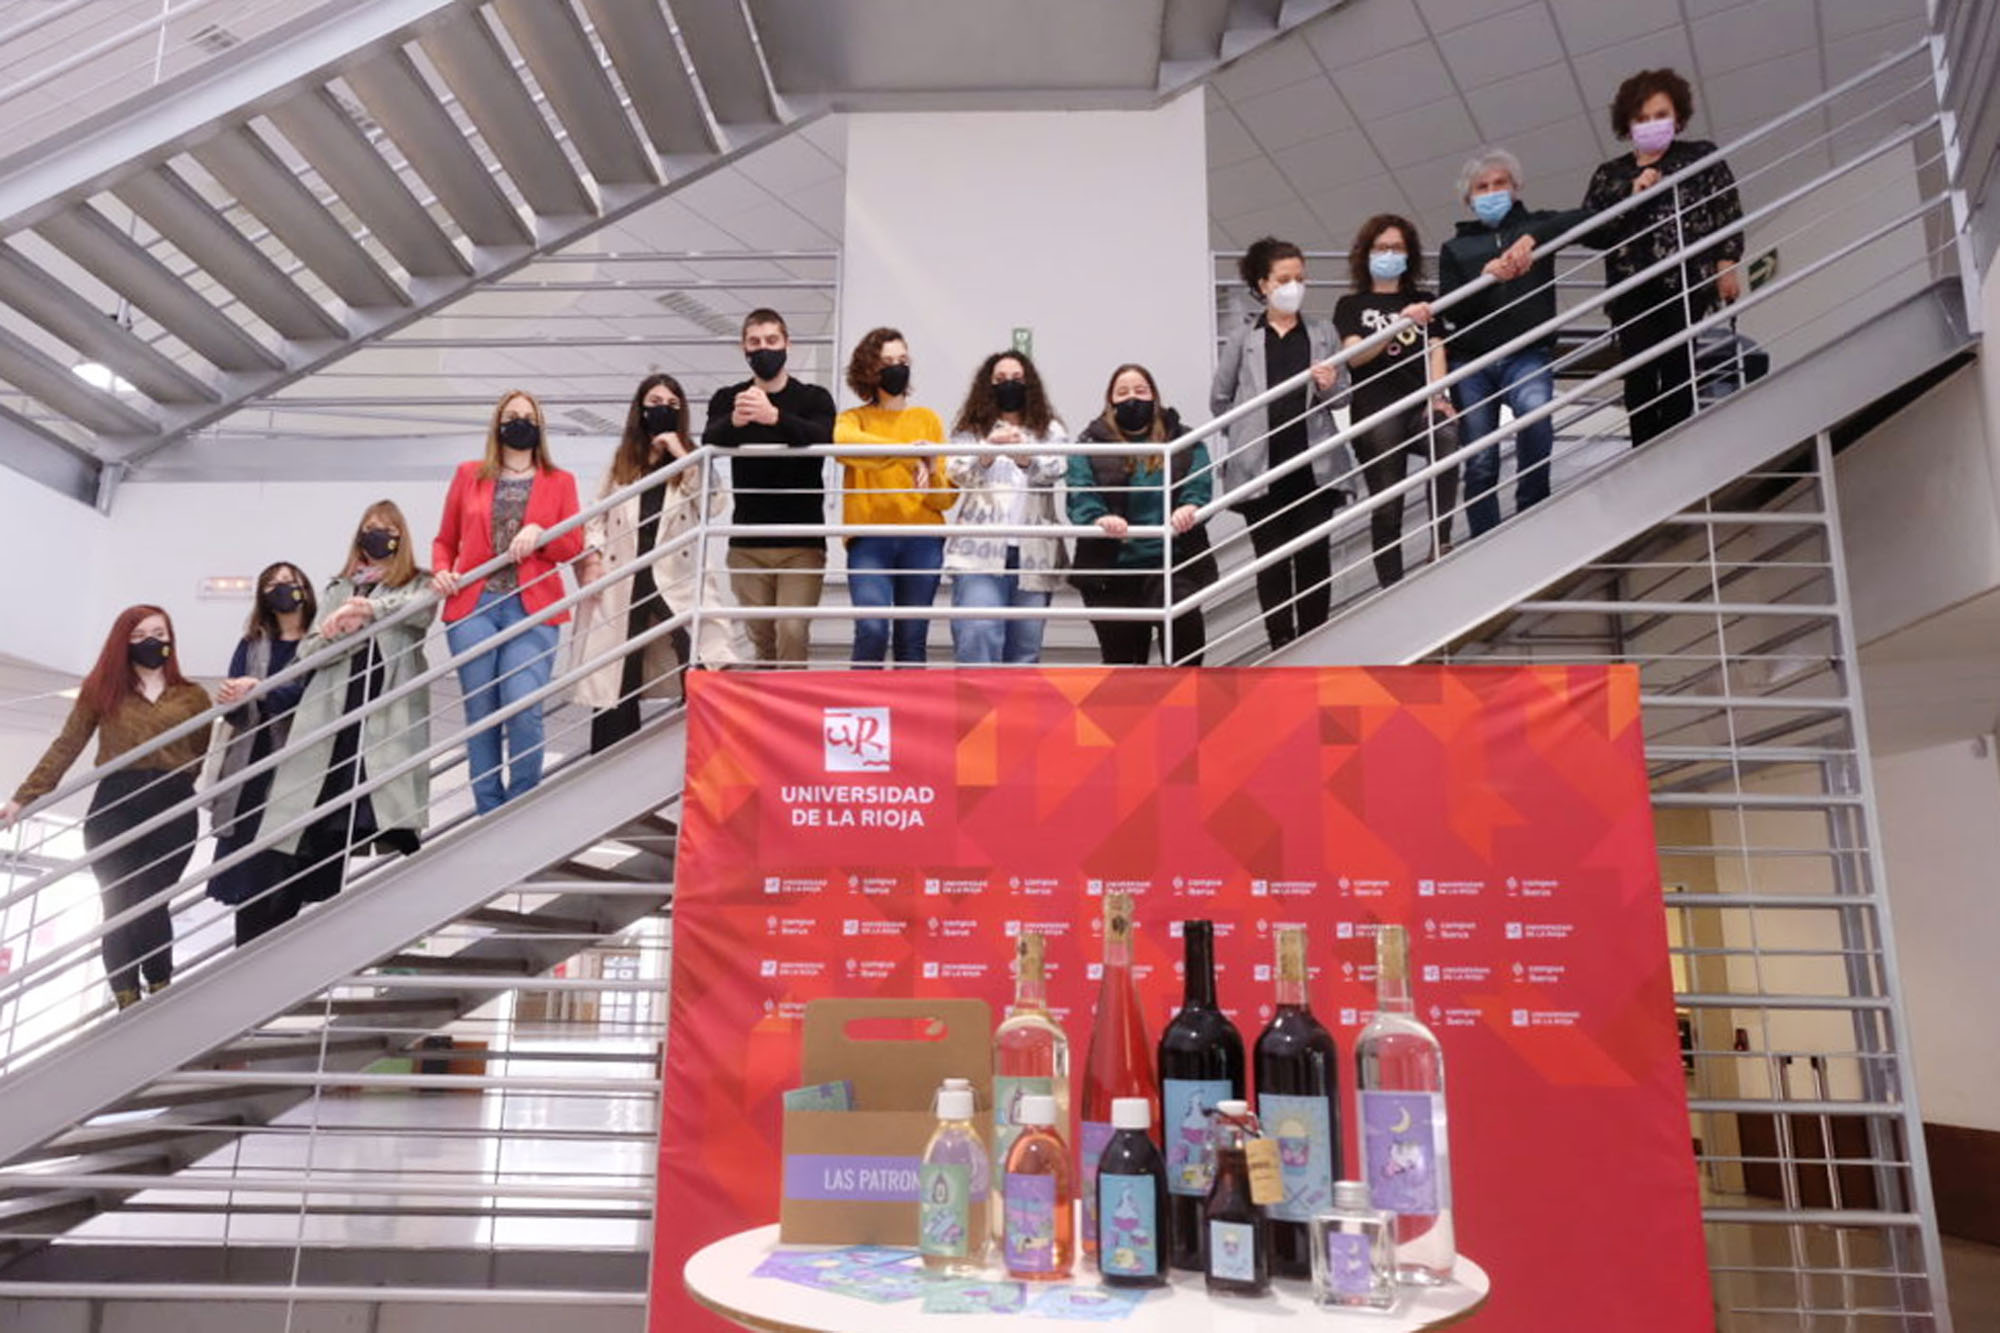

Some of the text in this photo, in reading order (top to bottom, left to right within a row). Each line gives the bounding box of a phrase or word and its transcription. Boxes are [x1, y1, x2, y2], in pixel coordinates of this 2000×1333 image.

[781, 786, 935, 803] UNIVERSIDAD
[791, 809, 925, 830] DE LA RIOJA
[824, 1168, 855, 1191] LAS
